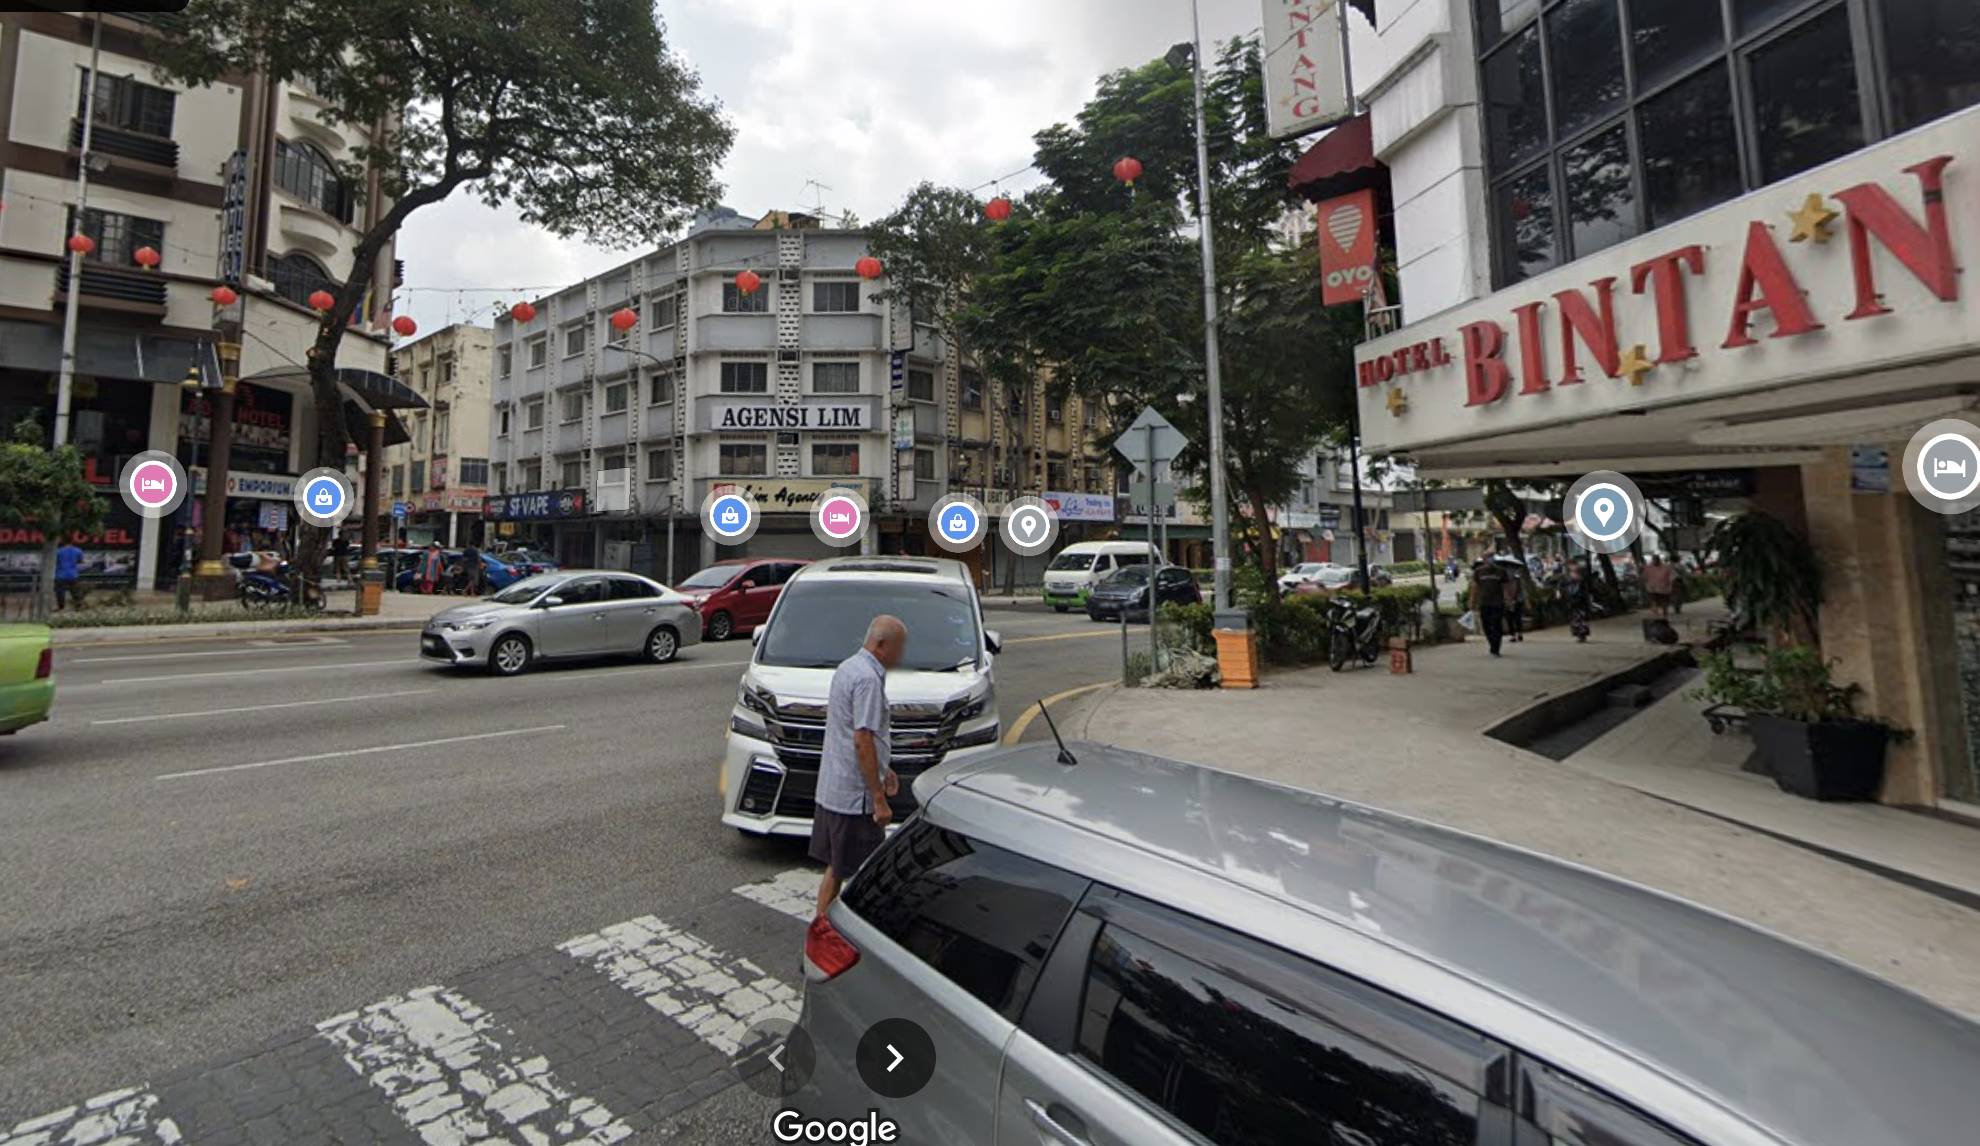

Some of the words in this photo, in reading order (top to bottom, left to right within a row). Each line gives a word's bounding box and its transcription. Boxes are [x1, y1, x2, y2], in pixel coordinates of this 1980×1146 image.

[1289, 0, 1320, 118] NTANG
[1327, 265, 1373, 288] OYO
[1359, 337, 1451, 388] HOTEL
[1458, 155, 1960, 408] BINTAN
[721, 407, 809, 427] AGENSI
[817, 407, 861, 427] LIM
[239, 477, 290, 494] EMPORIUM
[522, 495, 549, 516] VAPE
